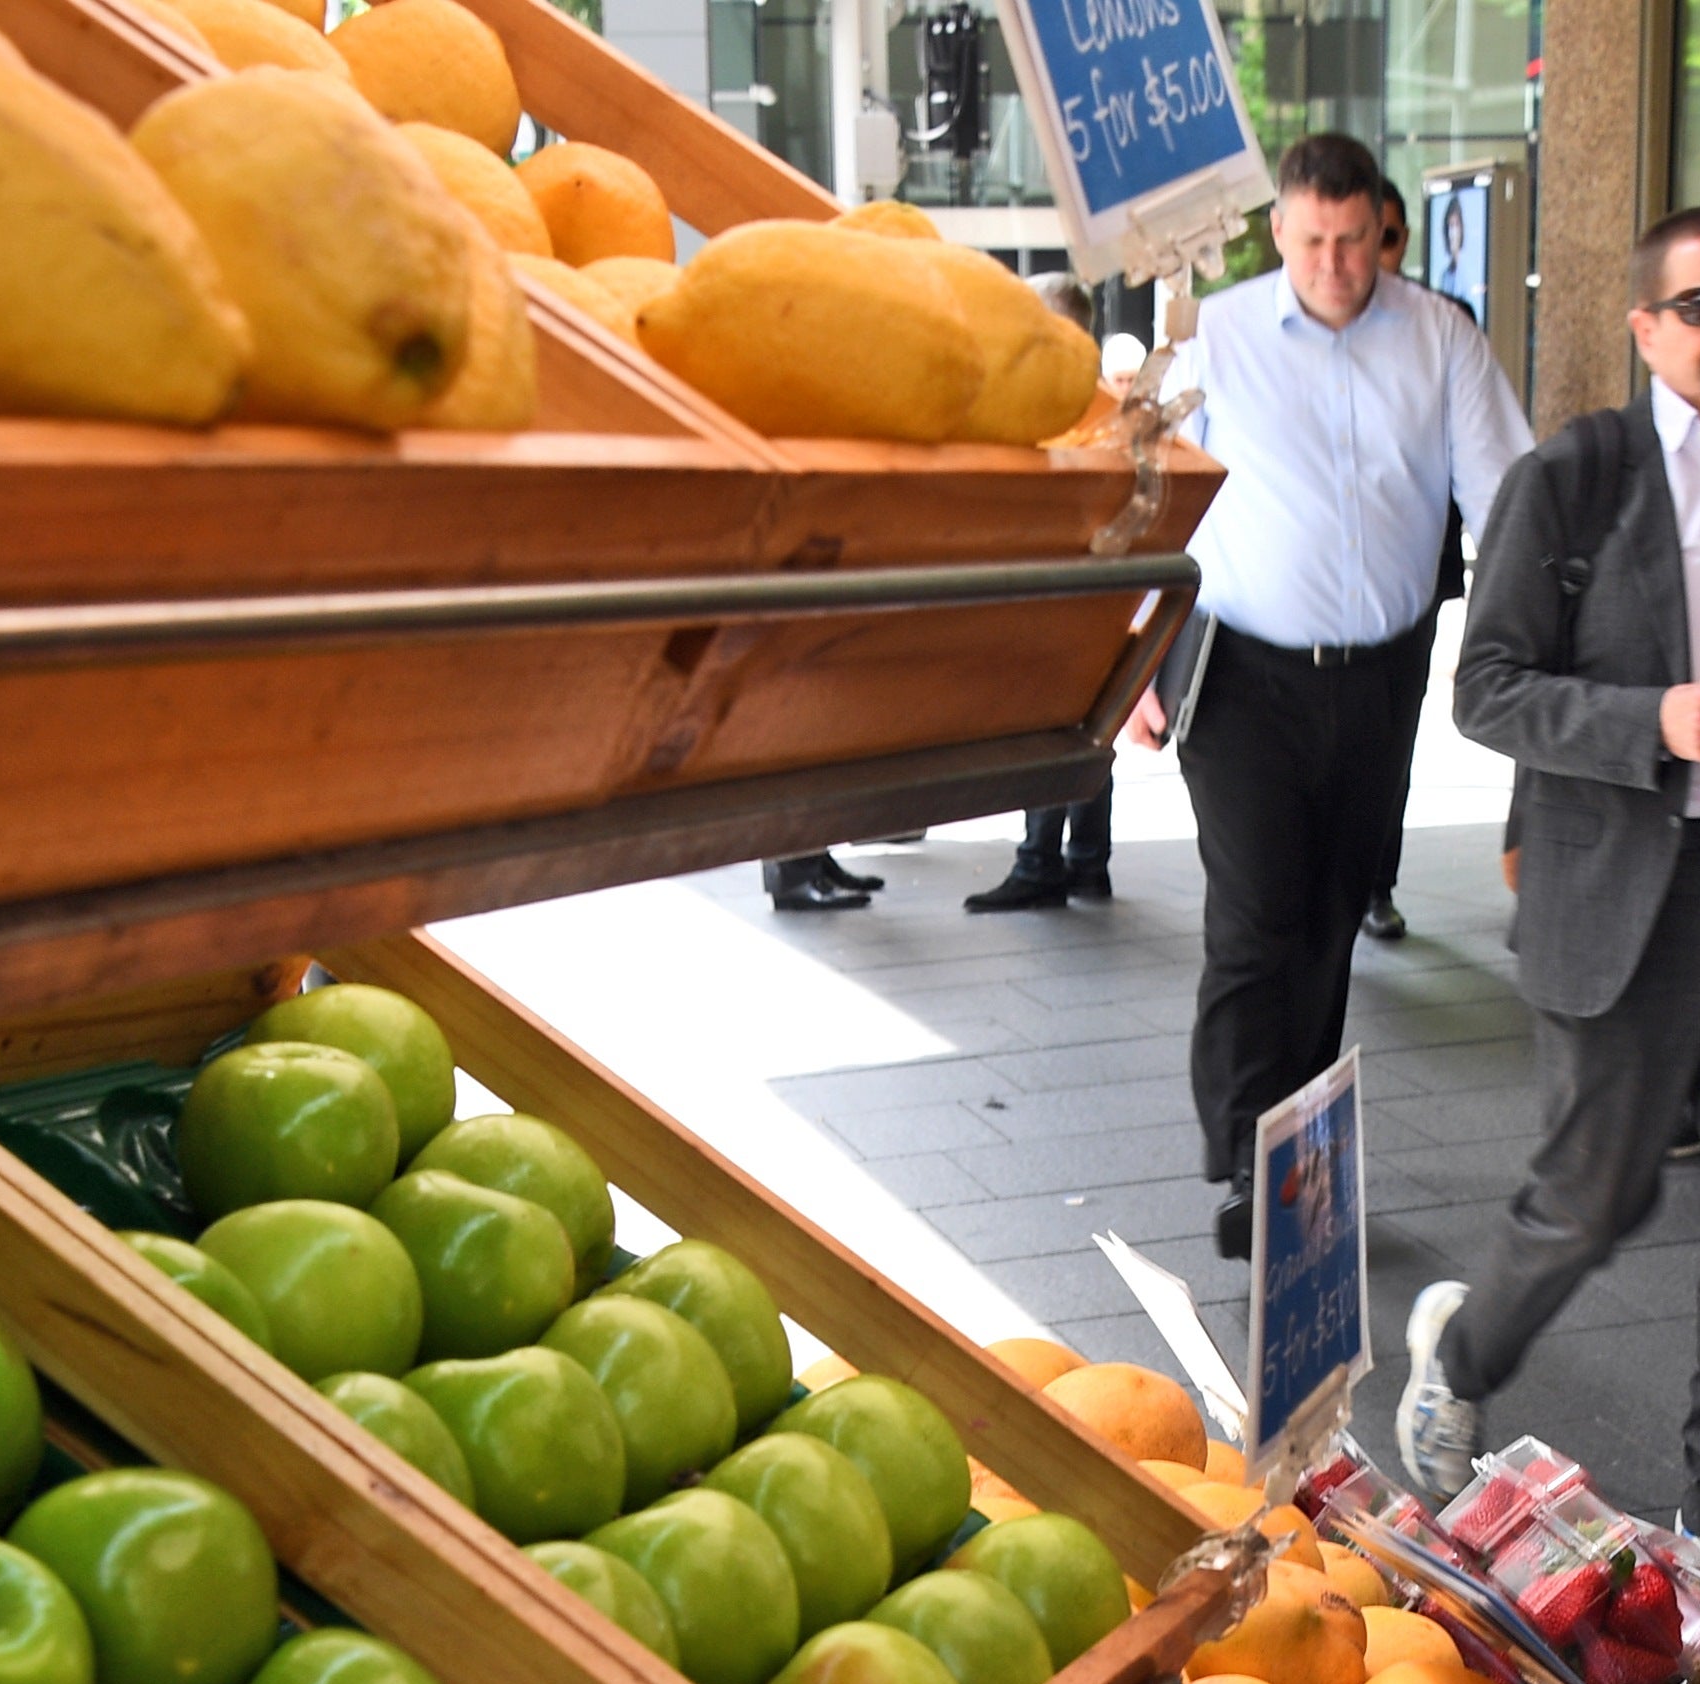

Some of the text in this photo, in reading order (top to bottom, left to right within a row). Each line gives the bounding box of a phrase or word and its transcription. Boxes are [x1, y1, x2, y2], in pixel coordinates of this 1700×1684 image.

[1062, 50, 1226, 178] 5 for $5.00
